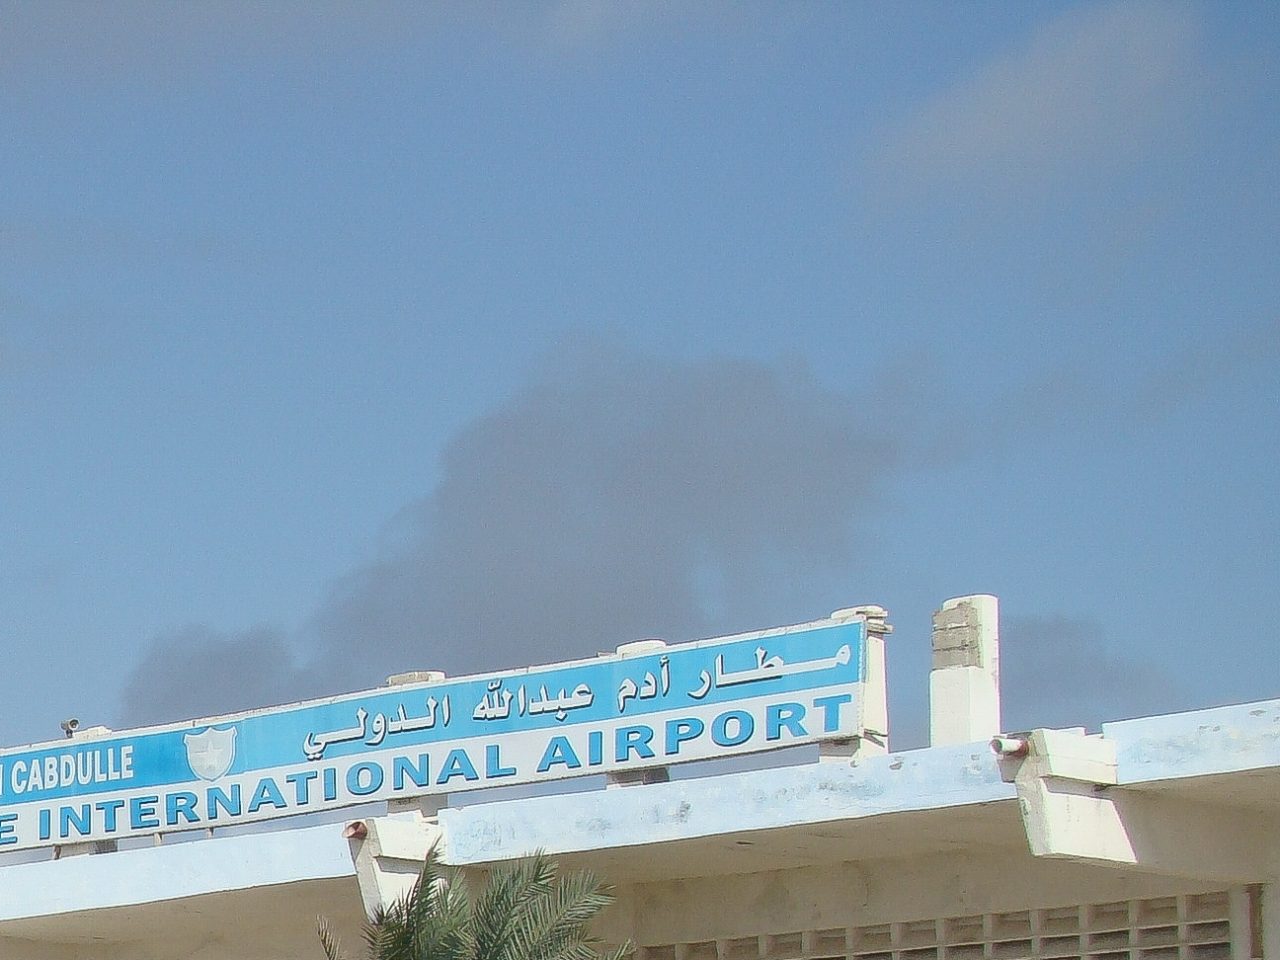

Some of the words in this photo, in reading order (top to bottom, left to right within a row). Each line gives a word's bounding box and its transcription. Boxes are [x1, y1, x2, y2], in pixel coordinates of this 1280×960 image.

[687, 644, 851, 700] مطار
[11, 745, 134, 792] CABDULLE
[38, 747, 517, 839] INTERNATIONAL
[537, 695, 852, 771] AIRPORT
